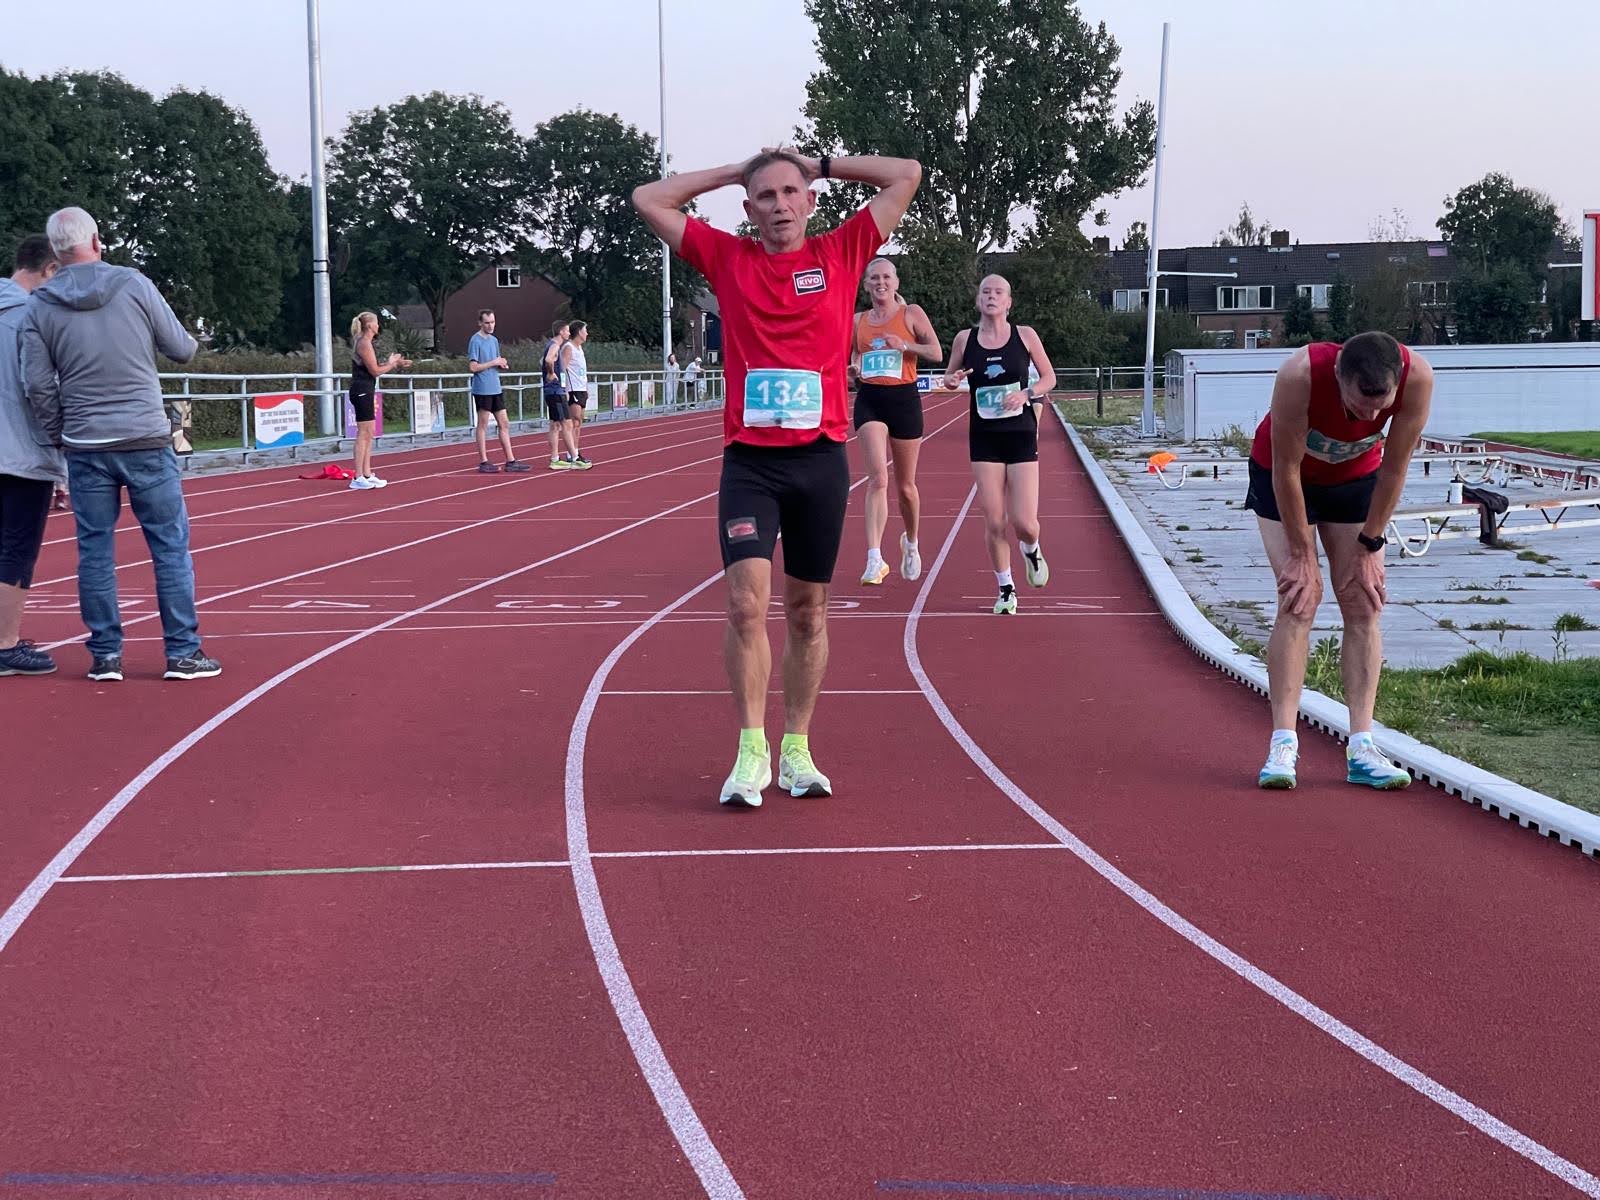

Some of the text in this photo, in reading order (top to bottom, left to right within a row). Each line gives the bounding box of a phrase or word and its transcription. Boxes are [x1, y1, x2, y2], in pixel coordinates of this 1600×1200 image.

[799, 277, 820, 287] KIVO
[868, 355, 897, 369] 119
[756, 380, 810, 406] 134
[985, 391, 1005, 406] 14
